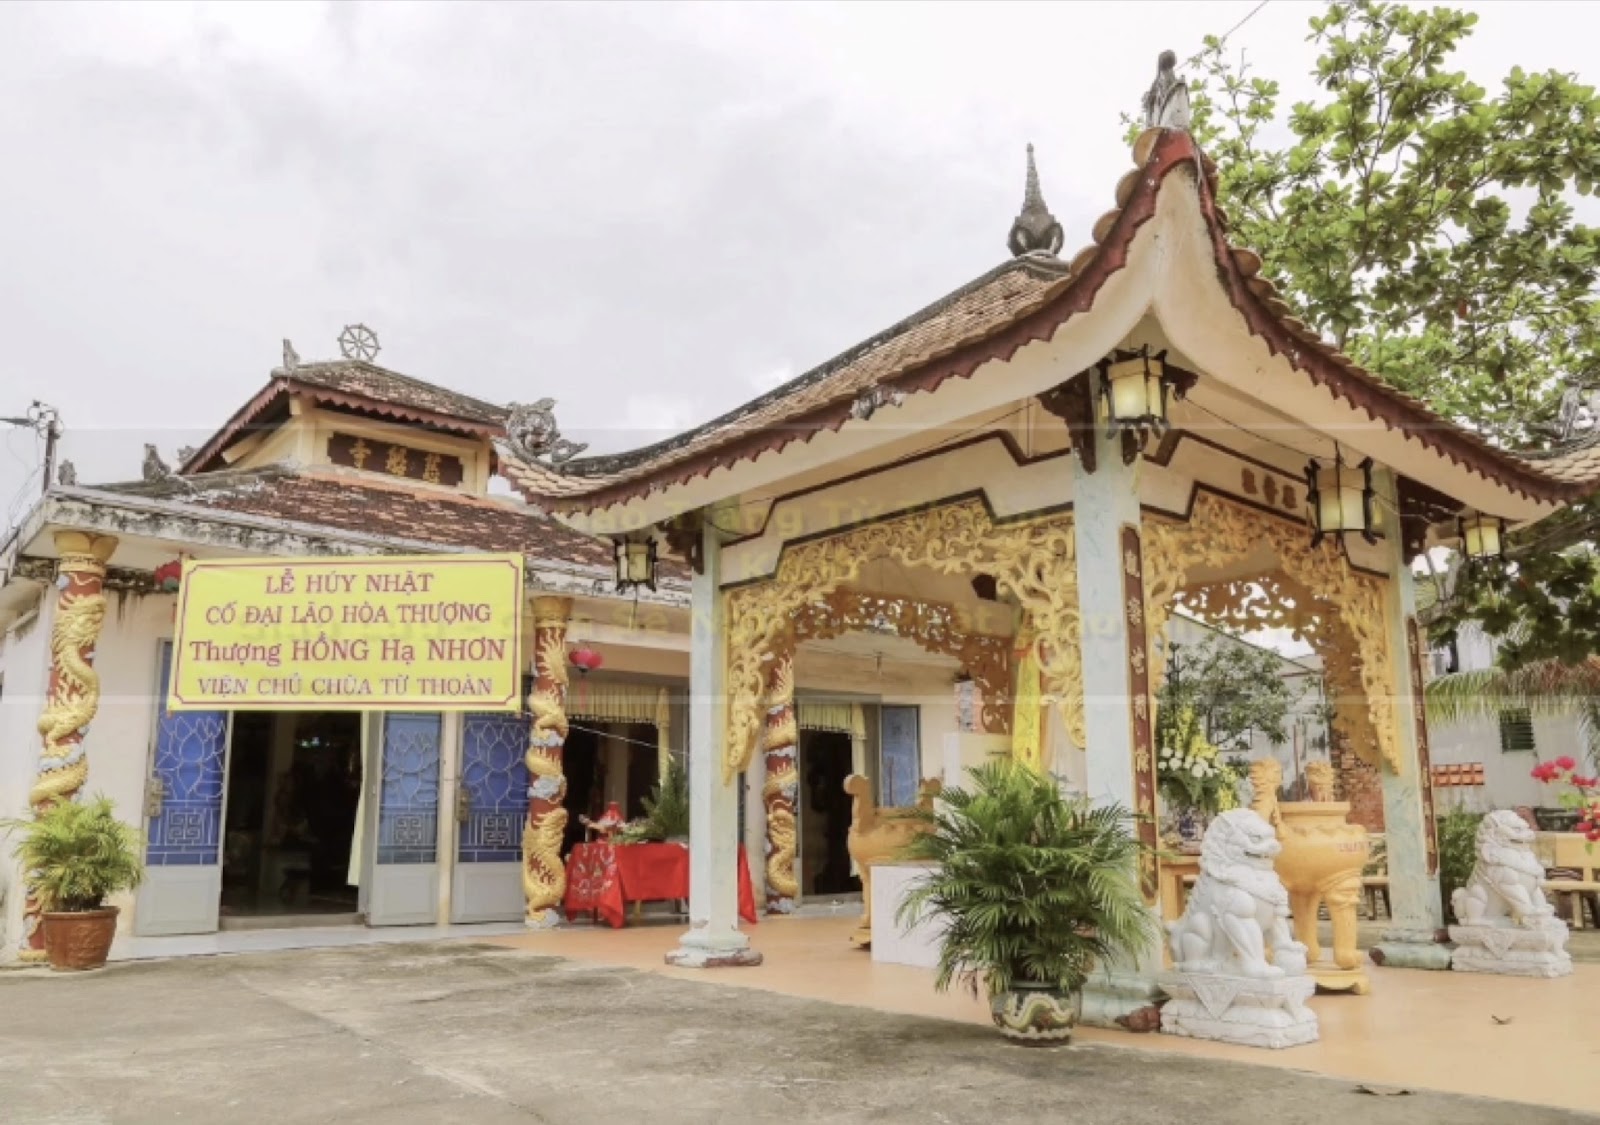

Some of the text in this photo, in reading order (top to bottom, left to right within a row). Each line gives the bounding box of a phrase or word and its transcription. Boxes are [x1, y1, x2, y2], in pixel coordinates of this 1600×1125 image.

[265, 568, 434, 596] LỄ HÚY NHẬT
[205, 600, 237, 624] CỐ
[245, 605, 283, 627] ĐẠI
[291, 601, 333, 624] LÃO
[397, 602, 491, 626] THƯỢNG
[190, 631, 507, 666] Thượng HỒNG Hạ NHƠN
[197, 678, 248, 698] VIỆN
